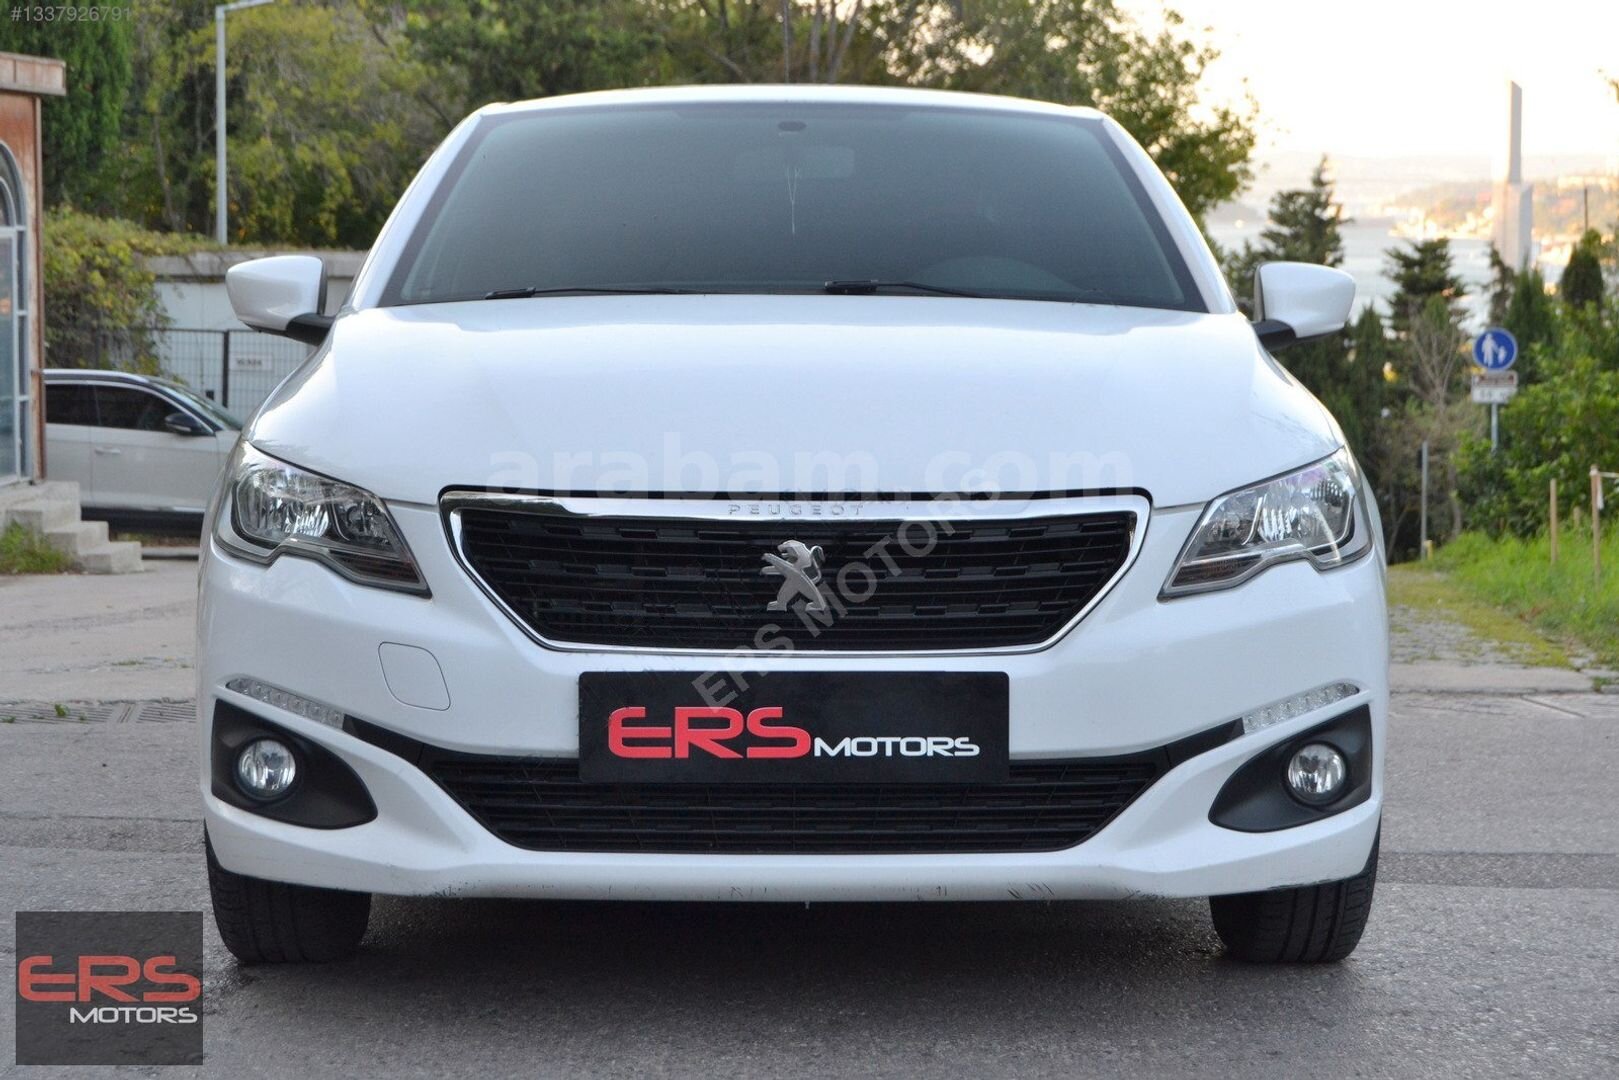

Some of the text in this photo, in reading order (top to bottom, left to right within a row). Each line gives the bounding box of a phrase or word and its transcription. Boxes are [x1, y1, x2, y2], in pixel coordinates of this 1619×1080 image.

[728, 503, 864, 516] PEUGEOT
[608, 706, 980, 759] ERS MOTORS
